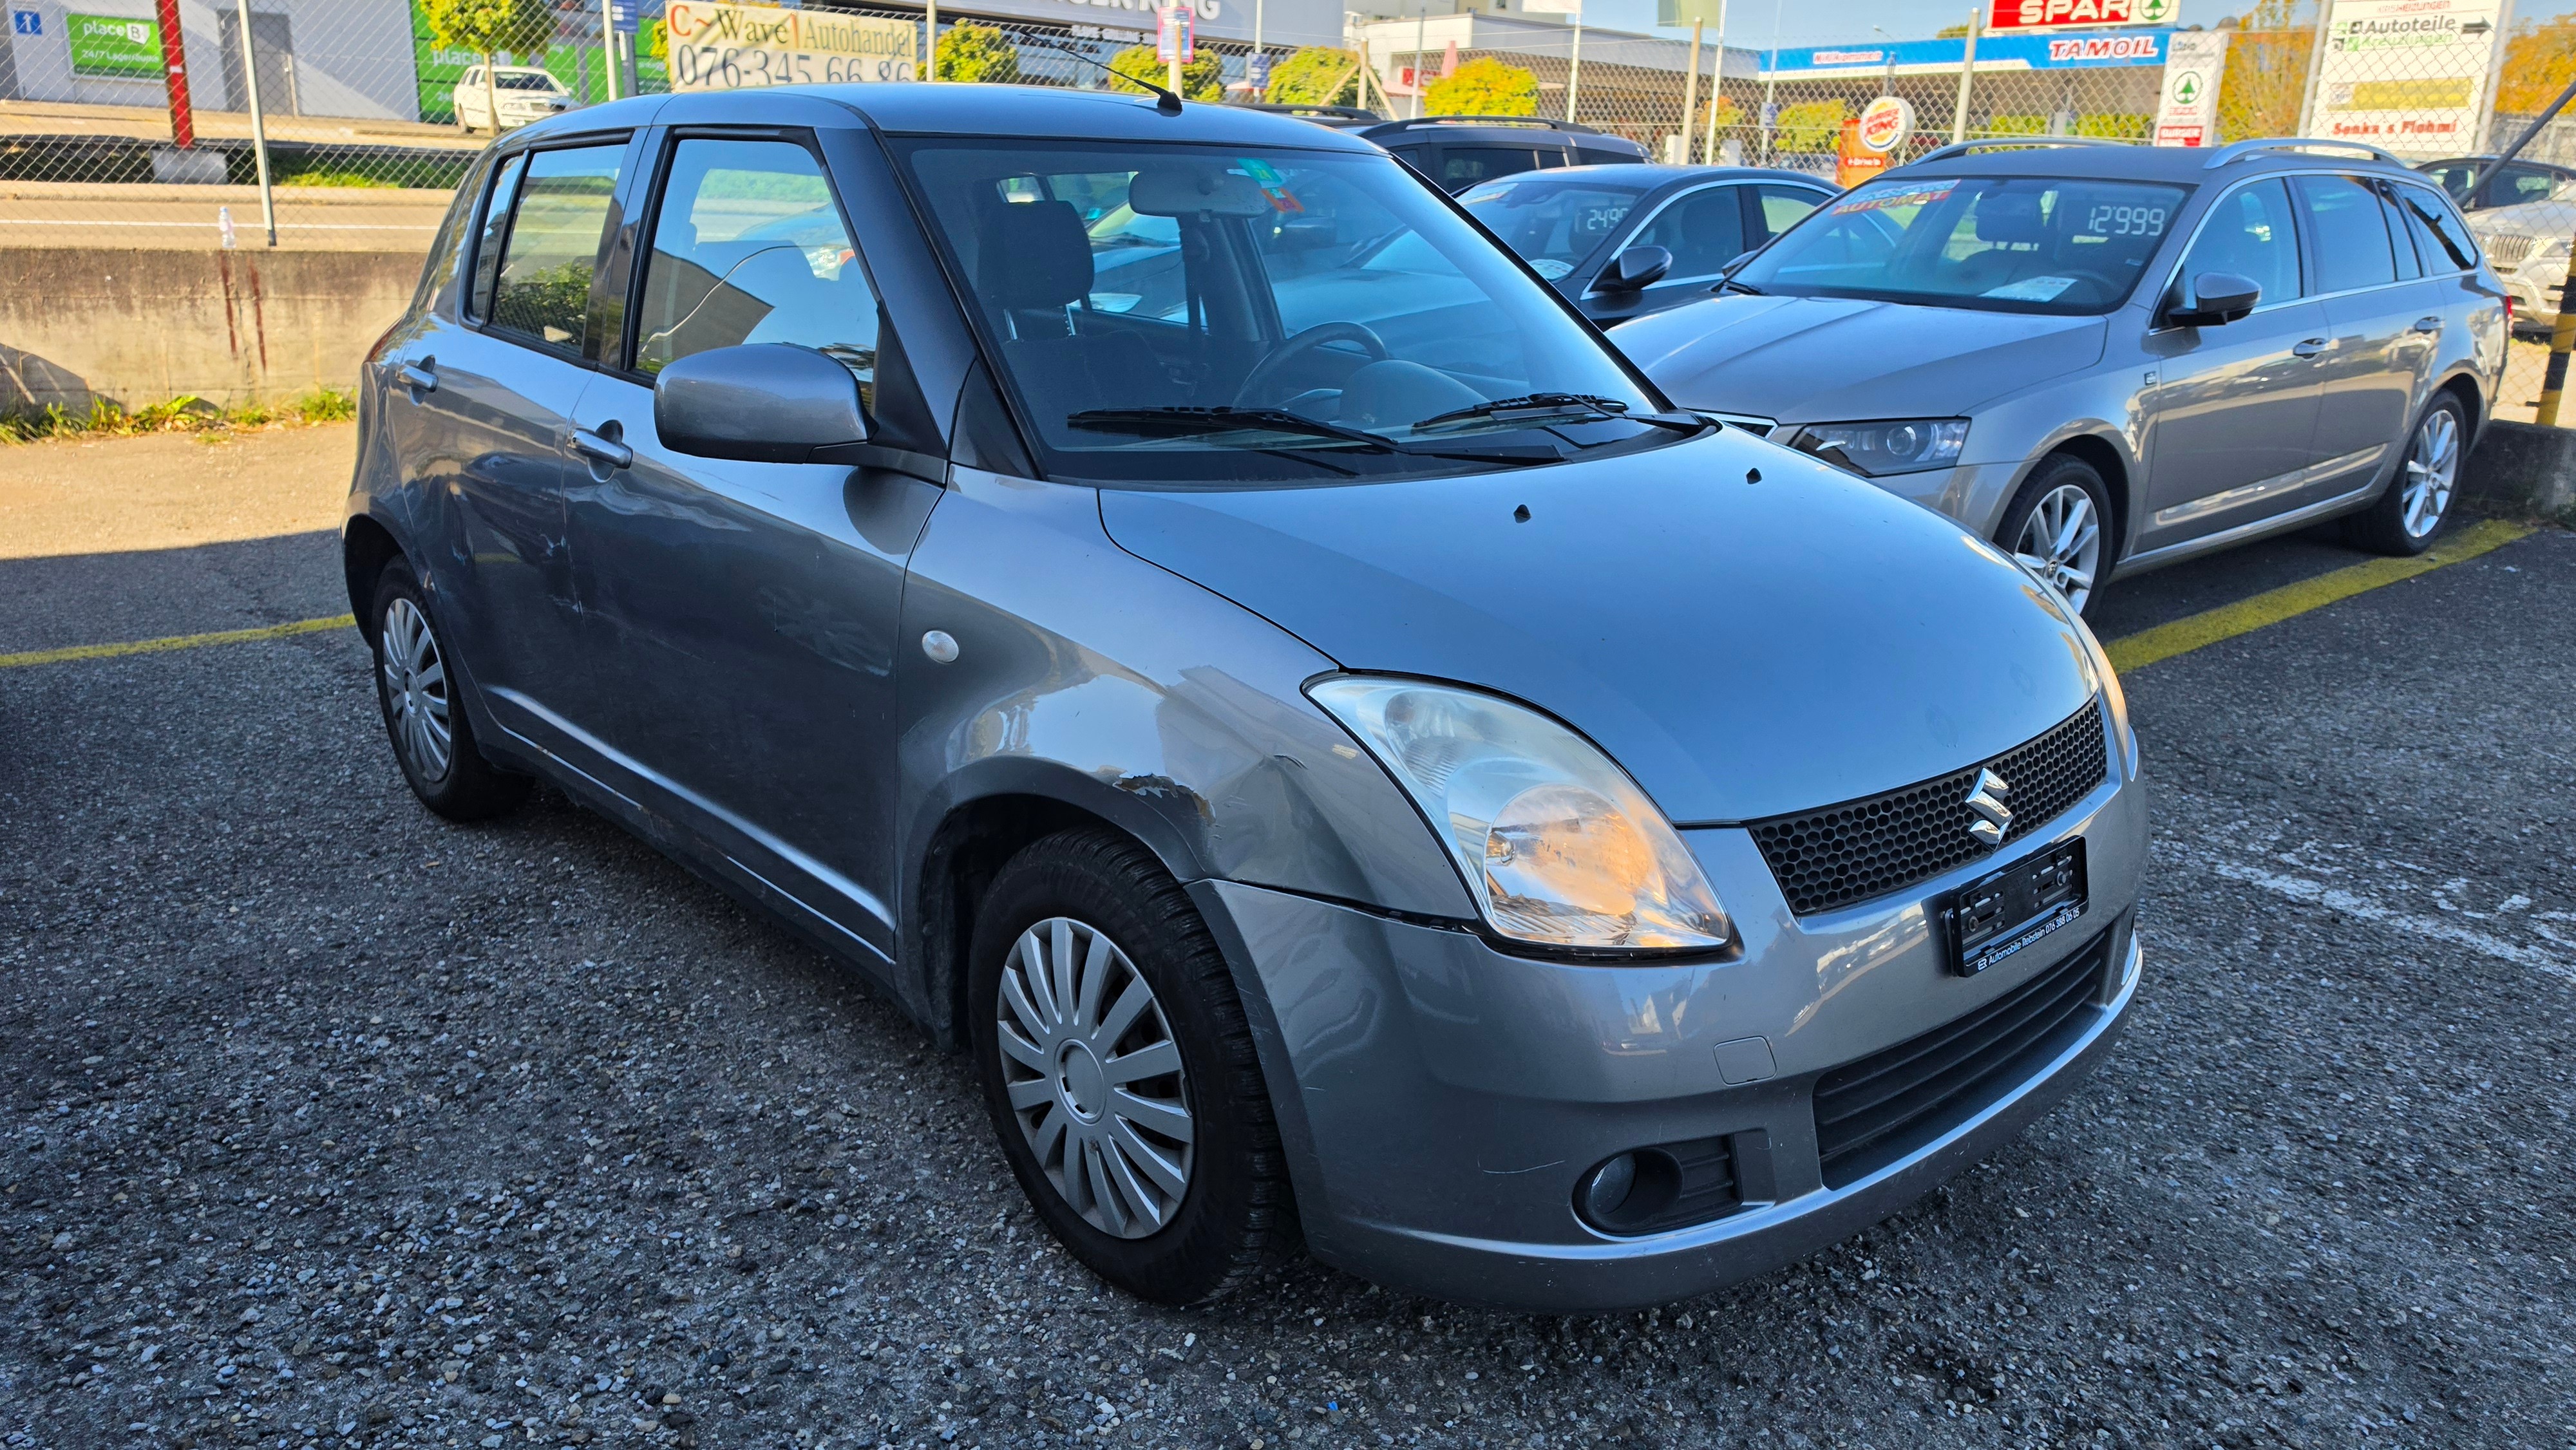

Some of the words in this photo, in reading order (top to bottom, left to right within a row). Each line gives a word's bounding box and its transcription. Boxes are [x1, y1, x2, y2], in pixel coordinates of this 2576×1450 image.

[2018, 0, 2130, 24] SPAR
[83, 21, 126, 37] place
[2365, 15, 2456, 34] Autoteile
[804, 17, 914, 58] Autohandel
[2050, 39, 2157, 59] TAMOIL
[1833, 189, 1953, 216] AUTOMAT
[1988, 941, 2022, 965] Automobile
[2022, 928, 2045, 947] Rebstein
[2045, 921, 2056, 934] 076
